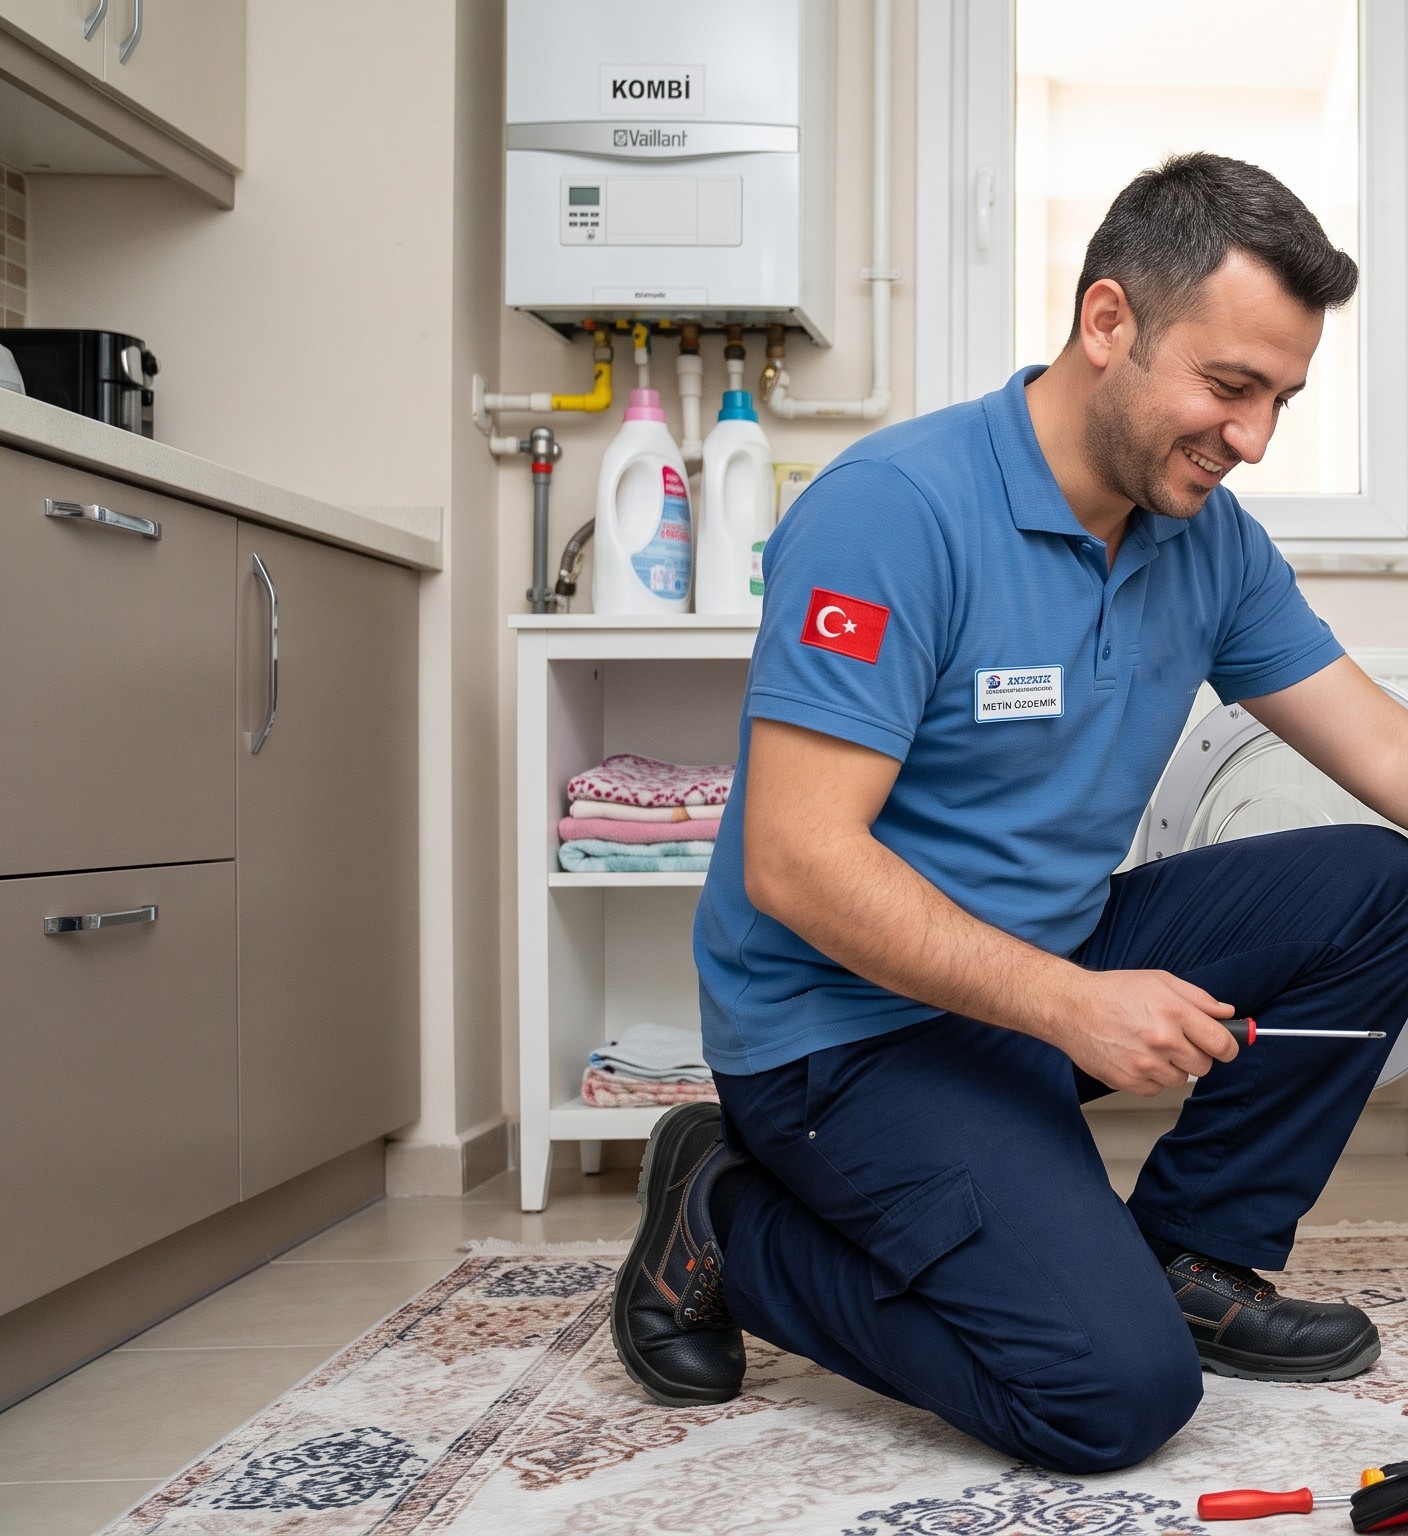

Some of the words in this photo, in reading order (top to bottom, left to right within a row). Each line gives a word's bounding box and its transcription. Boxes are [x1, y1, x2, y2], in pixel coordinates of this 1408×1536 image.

[612, 74, 690, 99] KOMBİ
[629, 129, 688, 147] Vaillant
[982, 701, 1012, 711] METİN
